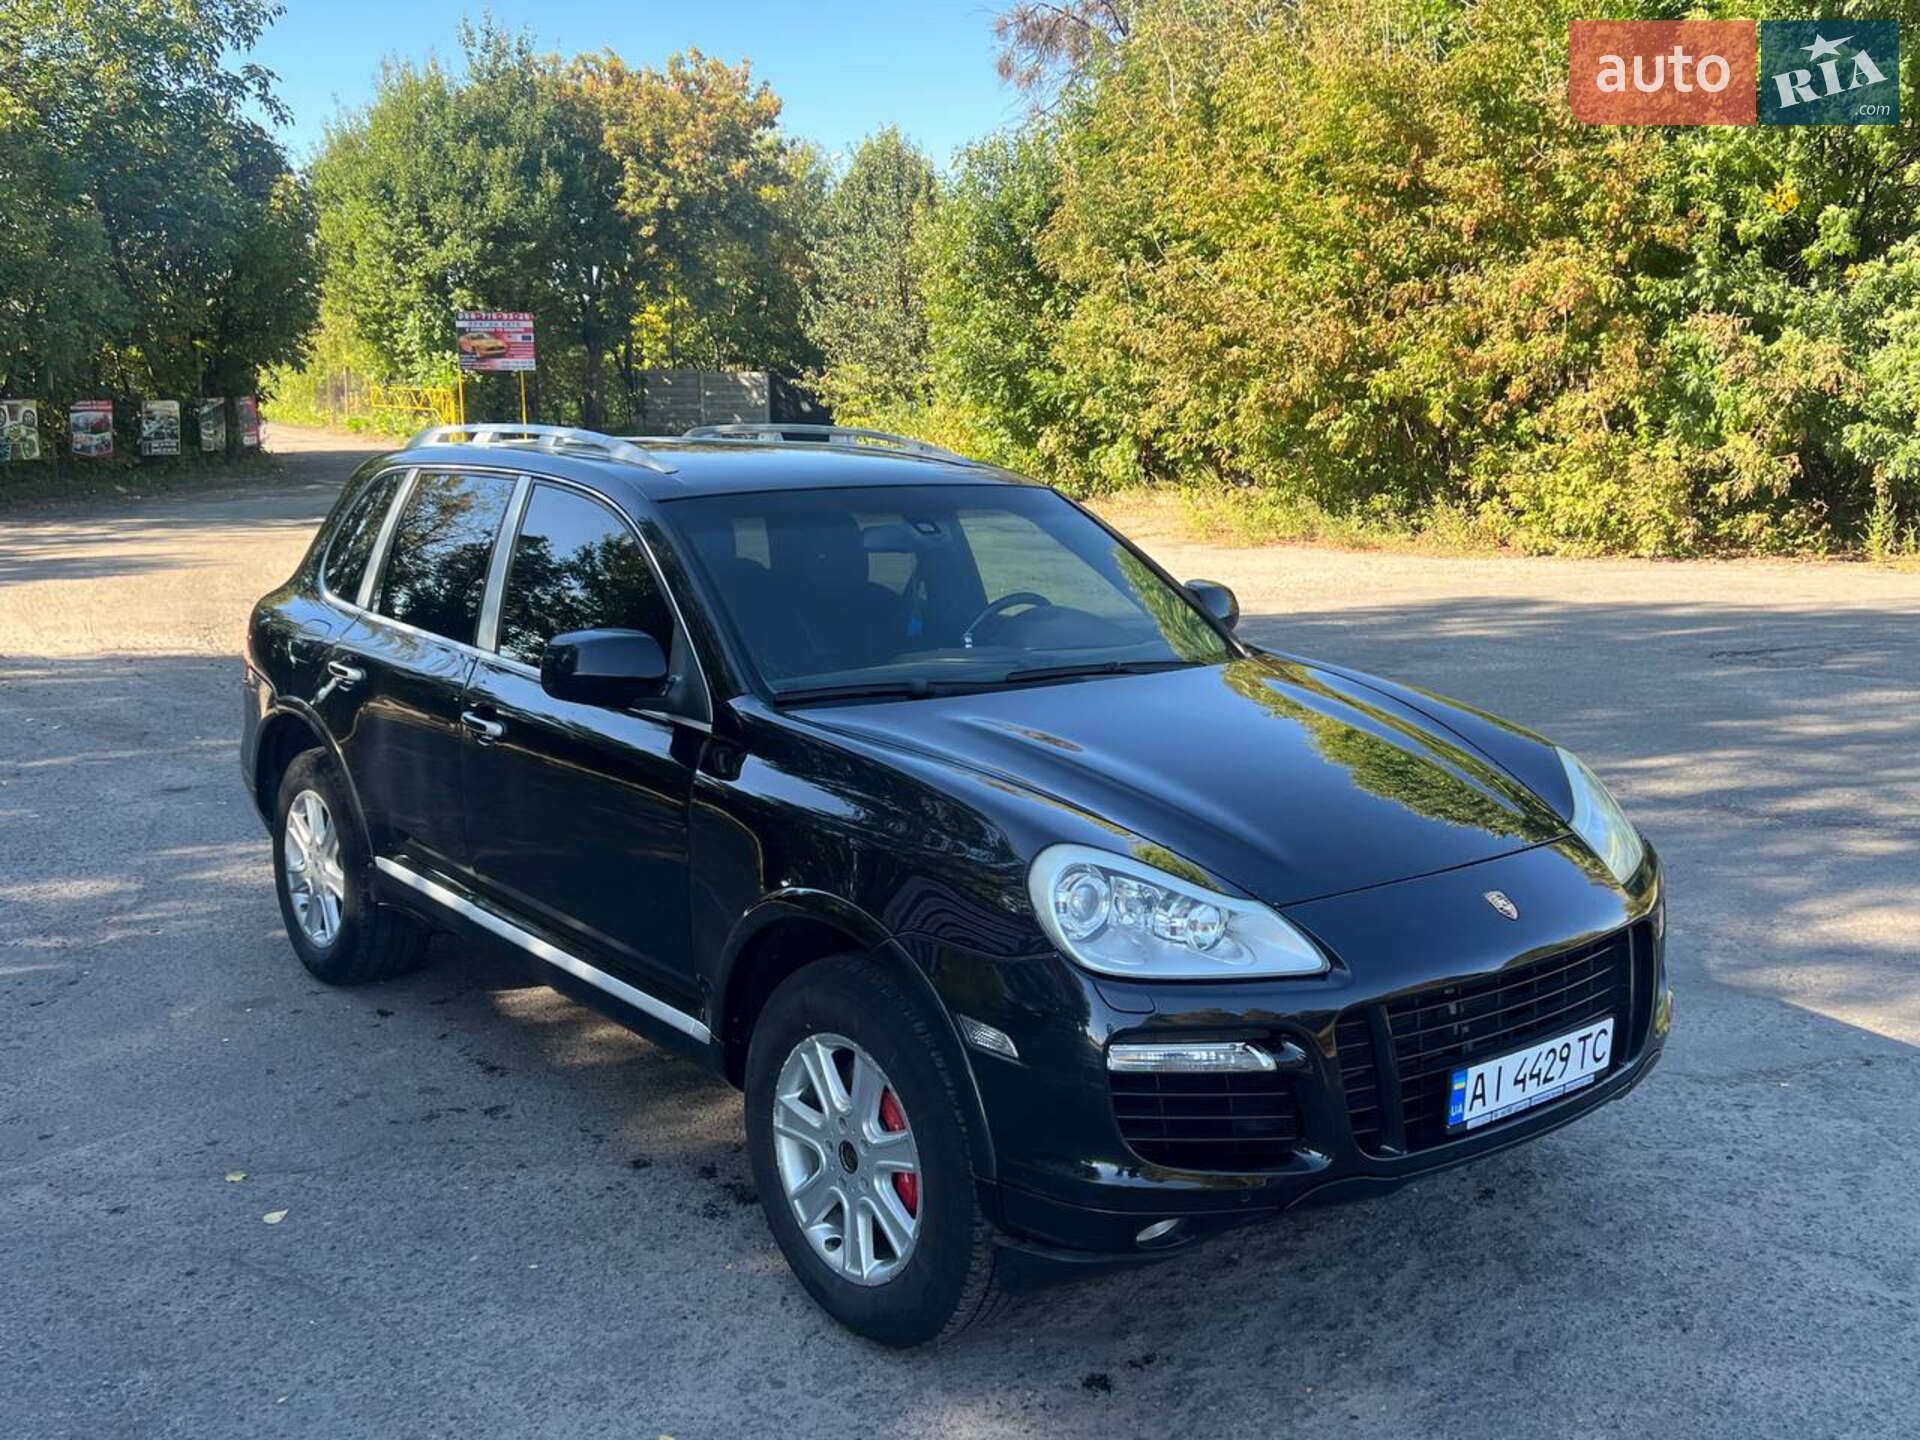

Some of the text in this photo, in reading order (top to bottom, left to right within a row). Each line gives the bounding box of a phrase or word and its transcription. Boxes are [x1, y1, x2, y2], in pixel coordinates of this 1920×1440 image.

[1468, 1065, 1503, 1112] AI
[1513, 1042, 1572, 1093] 4429
[1578, 1028, 1608, 1069] TC
